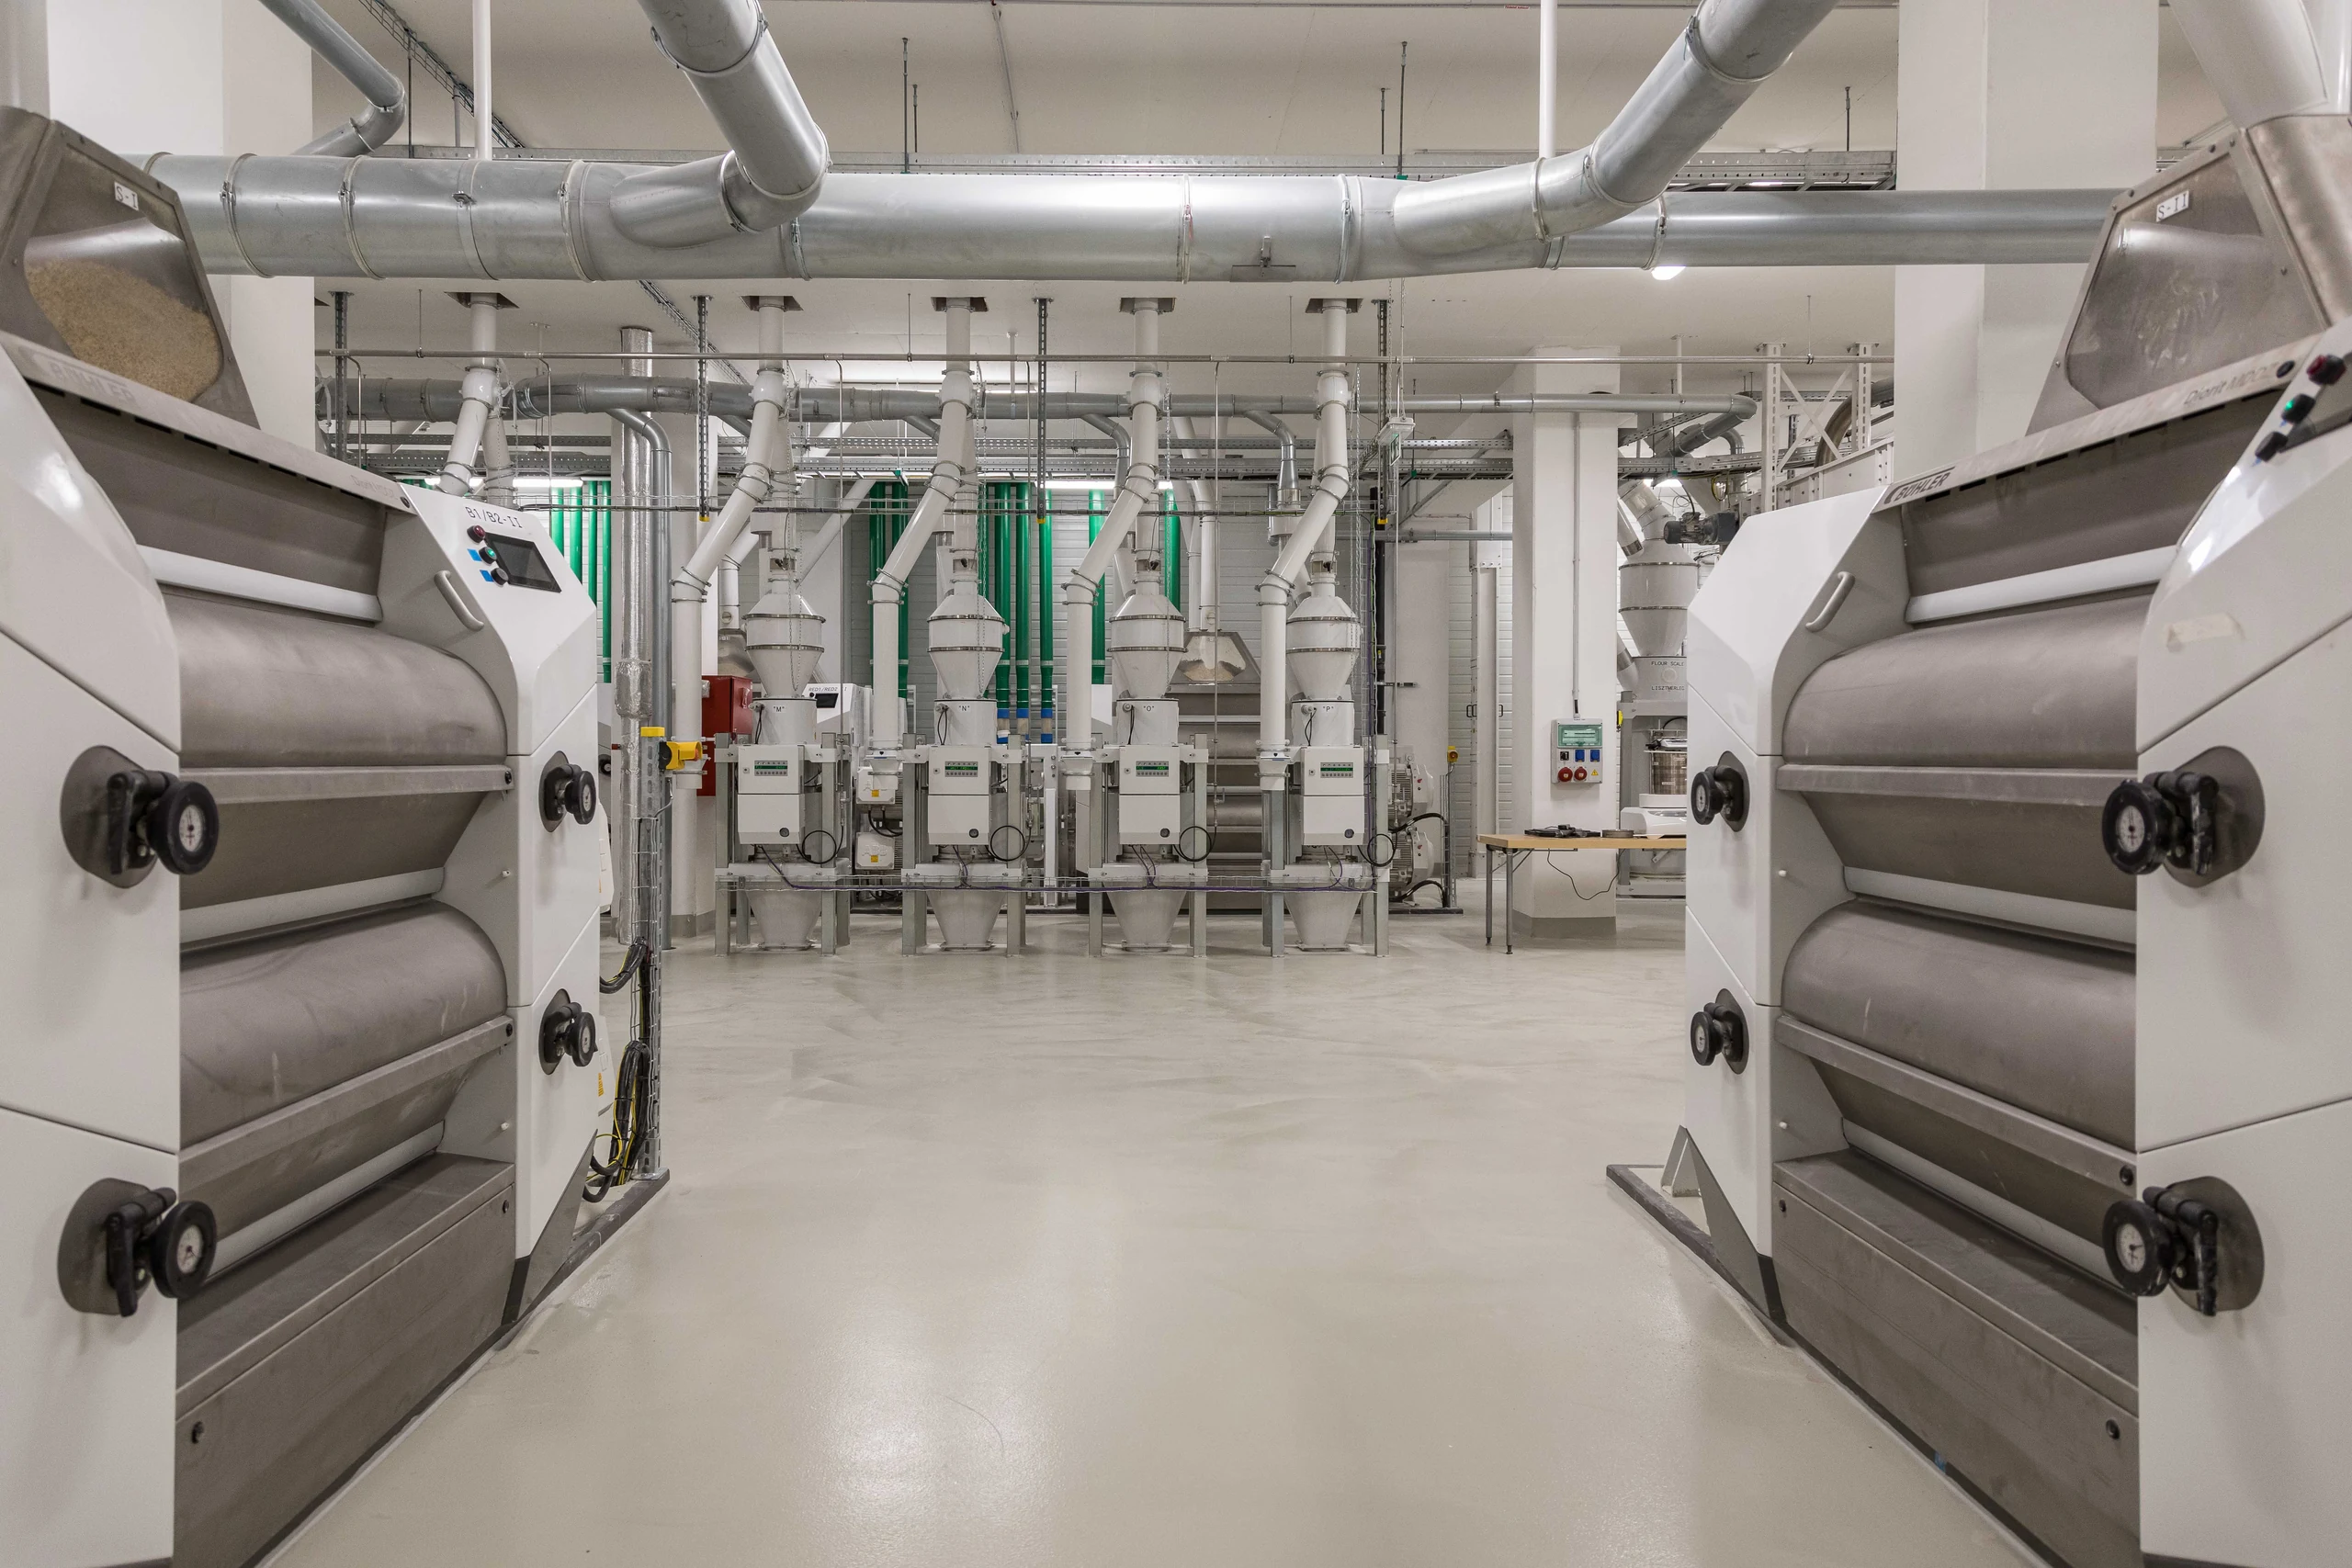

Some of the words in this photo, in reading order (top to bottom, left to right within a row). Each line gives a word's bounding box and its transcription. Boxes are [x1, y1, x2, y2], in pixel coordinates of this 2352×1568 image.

[116, 186, 137, 209] S-I
[2157, 193, 2187, 220] S-II
[465, 506, 523, 529] B1/B2-II
